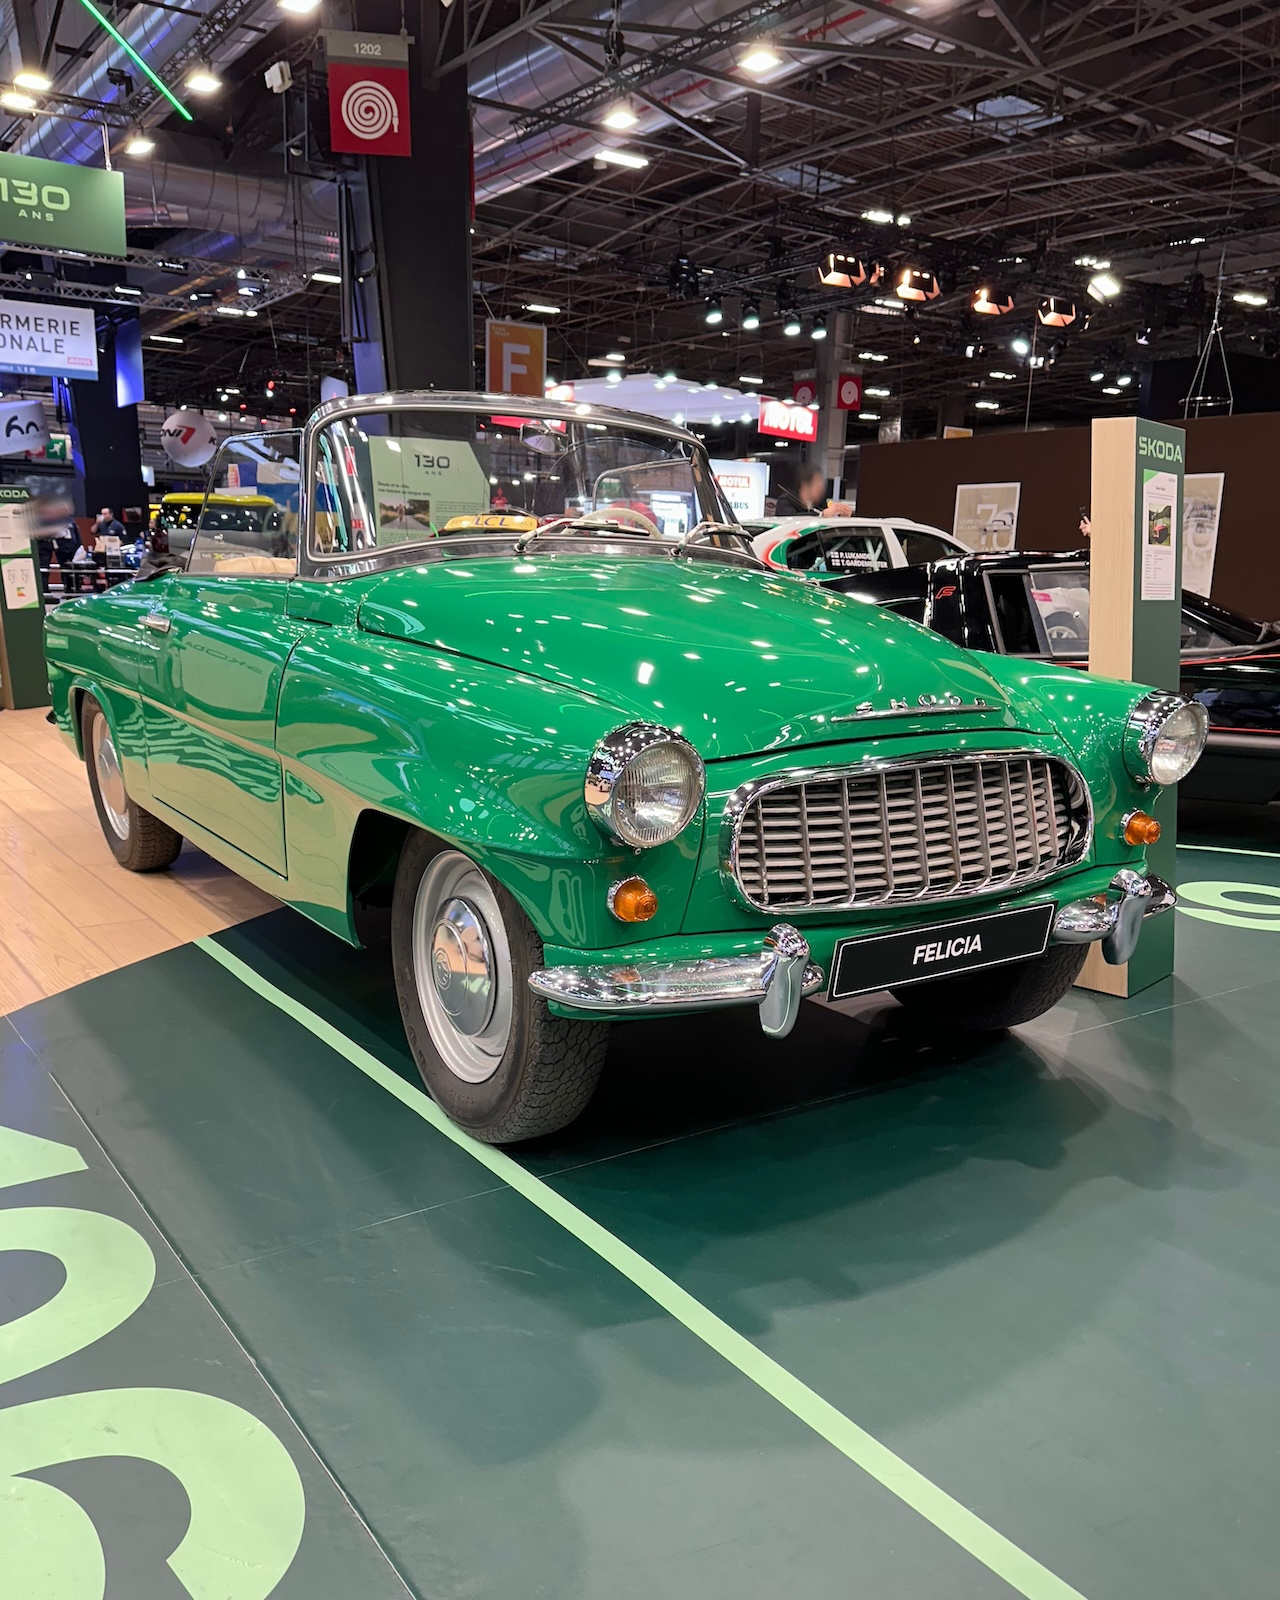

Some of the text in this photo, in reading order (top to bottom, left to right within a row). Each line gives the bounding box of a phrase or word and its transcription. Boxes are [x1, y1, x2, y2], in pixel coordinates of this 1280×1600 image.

[353, 42, 382, 56] 1202
[18, 208, 54, 222] ANS
[0, 313, 81, 337] RMERIE
[763, 401, 814, 435] MOTUL
[414, 454, 450, 469] 130
[474, 516, 510, 527] LCL
[912, 933, 982, 966] FELICIA
